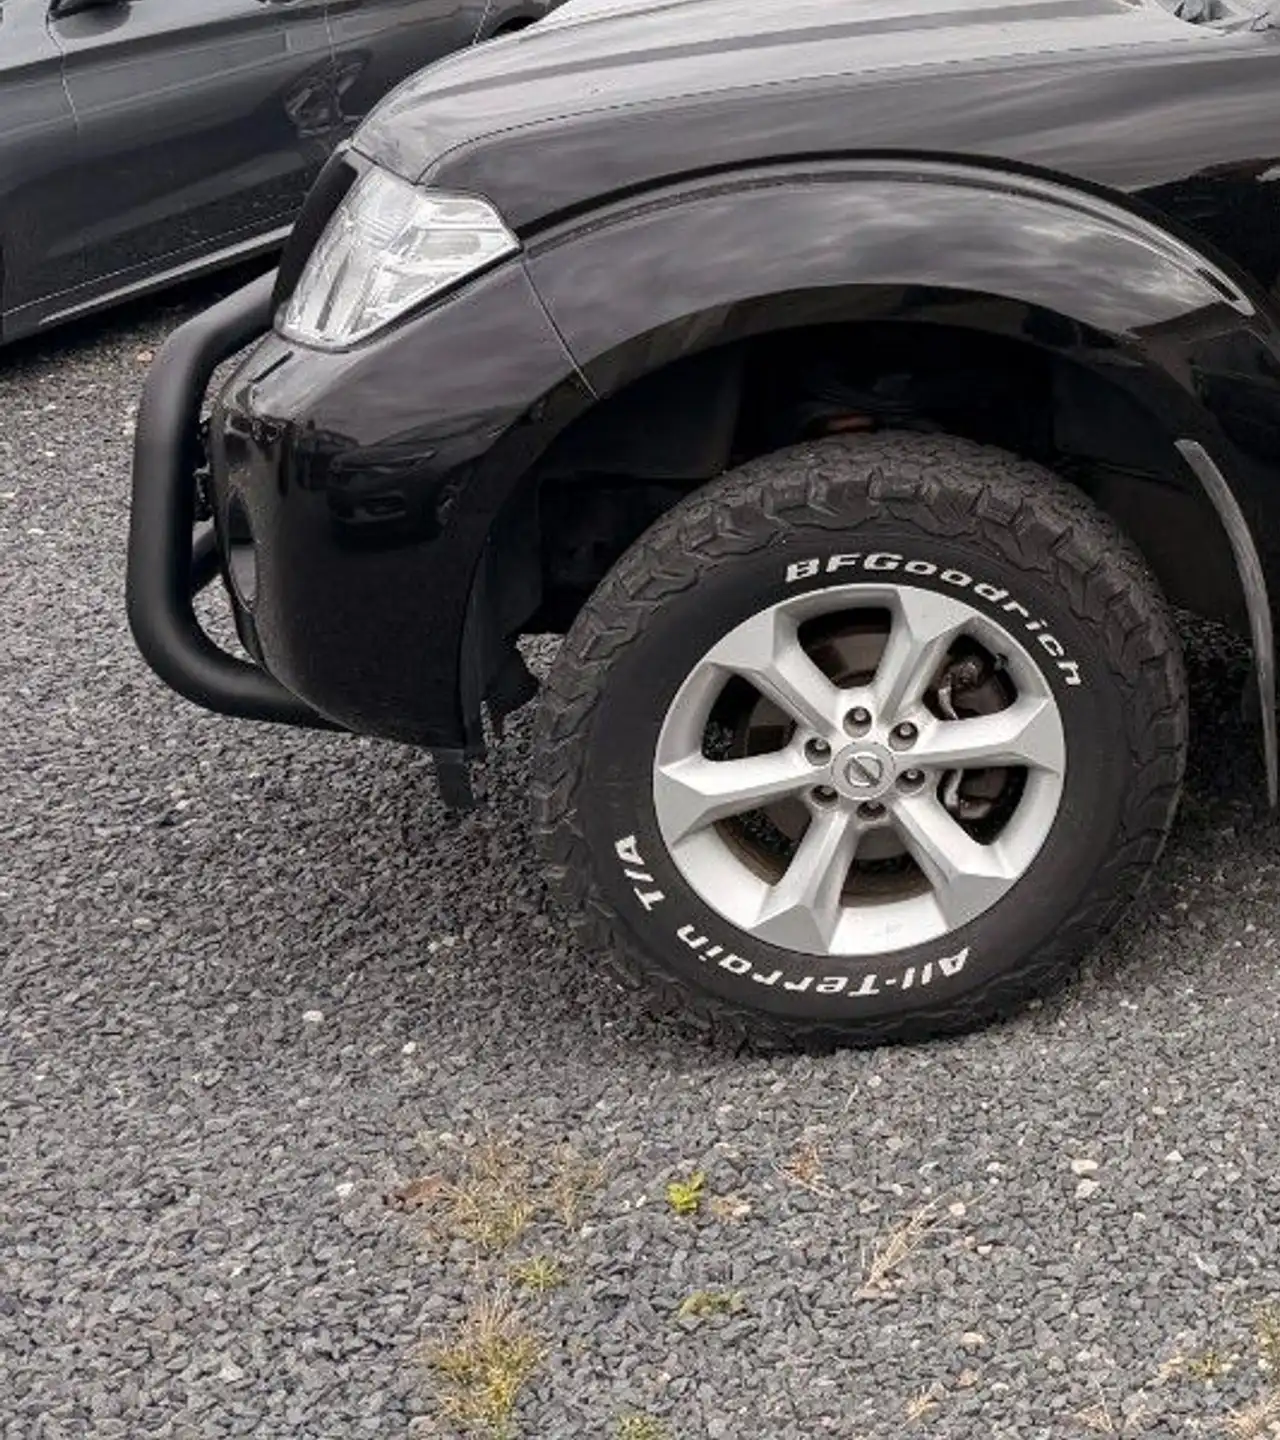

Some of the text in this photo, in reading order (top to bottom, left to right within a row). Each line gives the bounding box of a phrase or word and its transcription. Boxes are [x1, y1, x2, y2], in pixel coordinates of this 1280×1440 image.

[785, 552, 1082, 687] BFGoodrich
[614, 834, 971, 998] All-Terrain T/A
